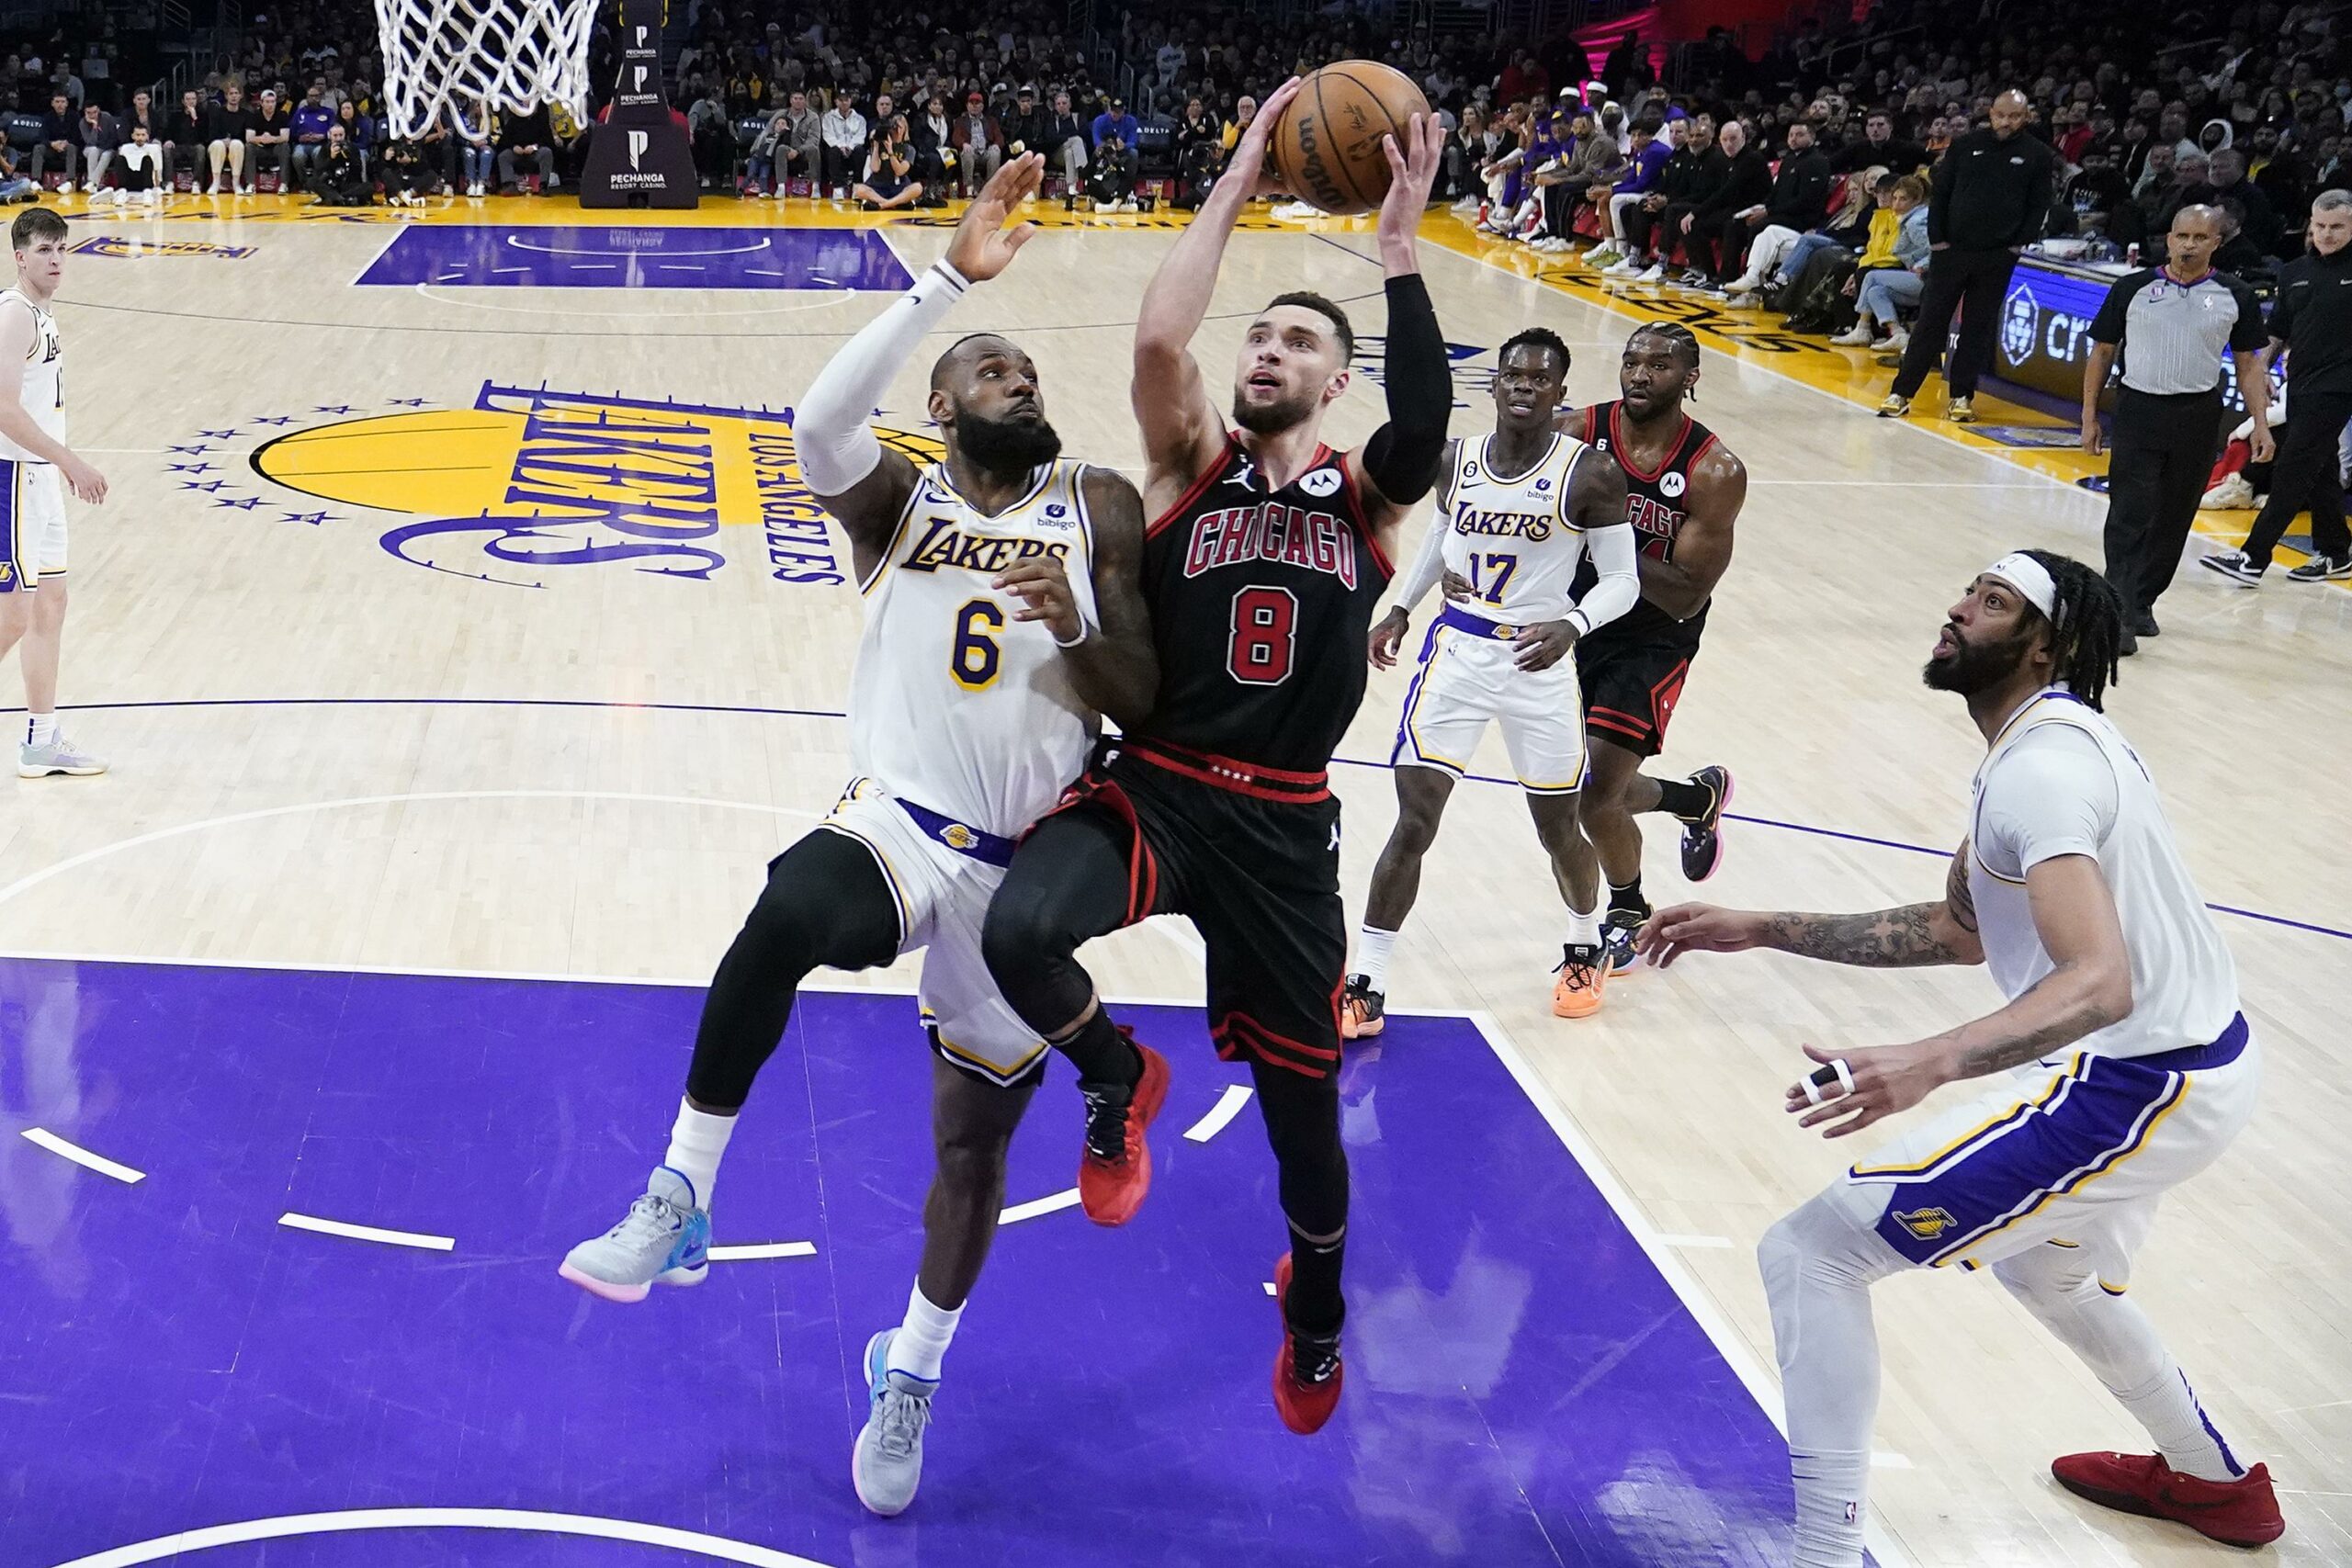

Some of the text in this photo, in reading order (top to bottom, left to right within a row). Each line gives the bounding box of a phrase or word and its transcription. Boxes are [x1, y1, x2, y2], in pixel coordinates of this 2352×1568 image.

[620, 94, 659, 102] PECHANGA
[610, 174, 665, 184] PECHANGA
[379, 379, 796, 590] LAKERS
[1465, 462, 1477, 477] 6
[1527, 491, 1554, 502] bibigo
[754, 469, 846, 586] ANGELES
[1037, 517, 1077, 531] bibigo
[1454, 501, 1554, 542] LAKERS
[1183, 501, 1358, 592] CHICAGO
[1469, 552, 1517, 608] 17
[949, 596, 1006, 693] 6
[1226, 584, 1299, 686] 8
